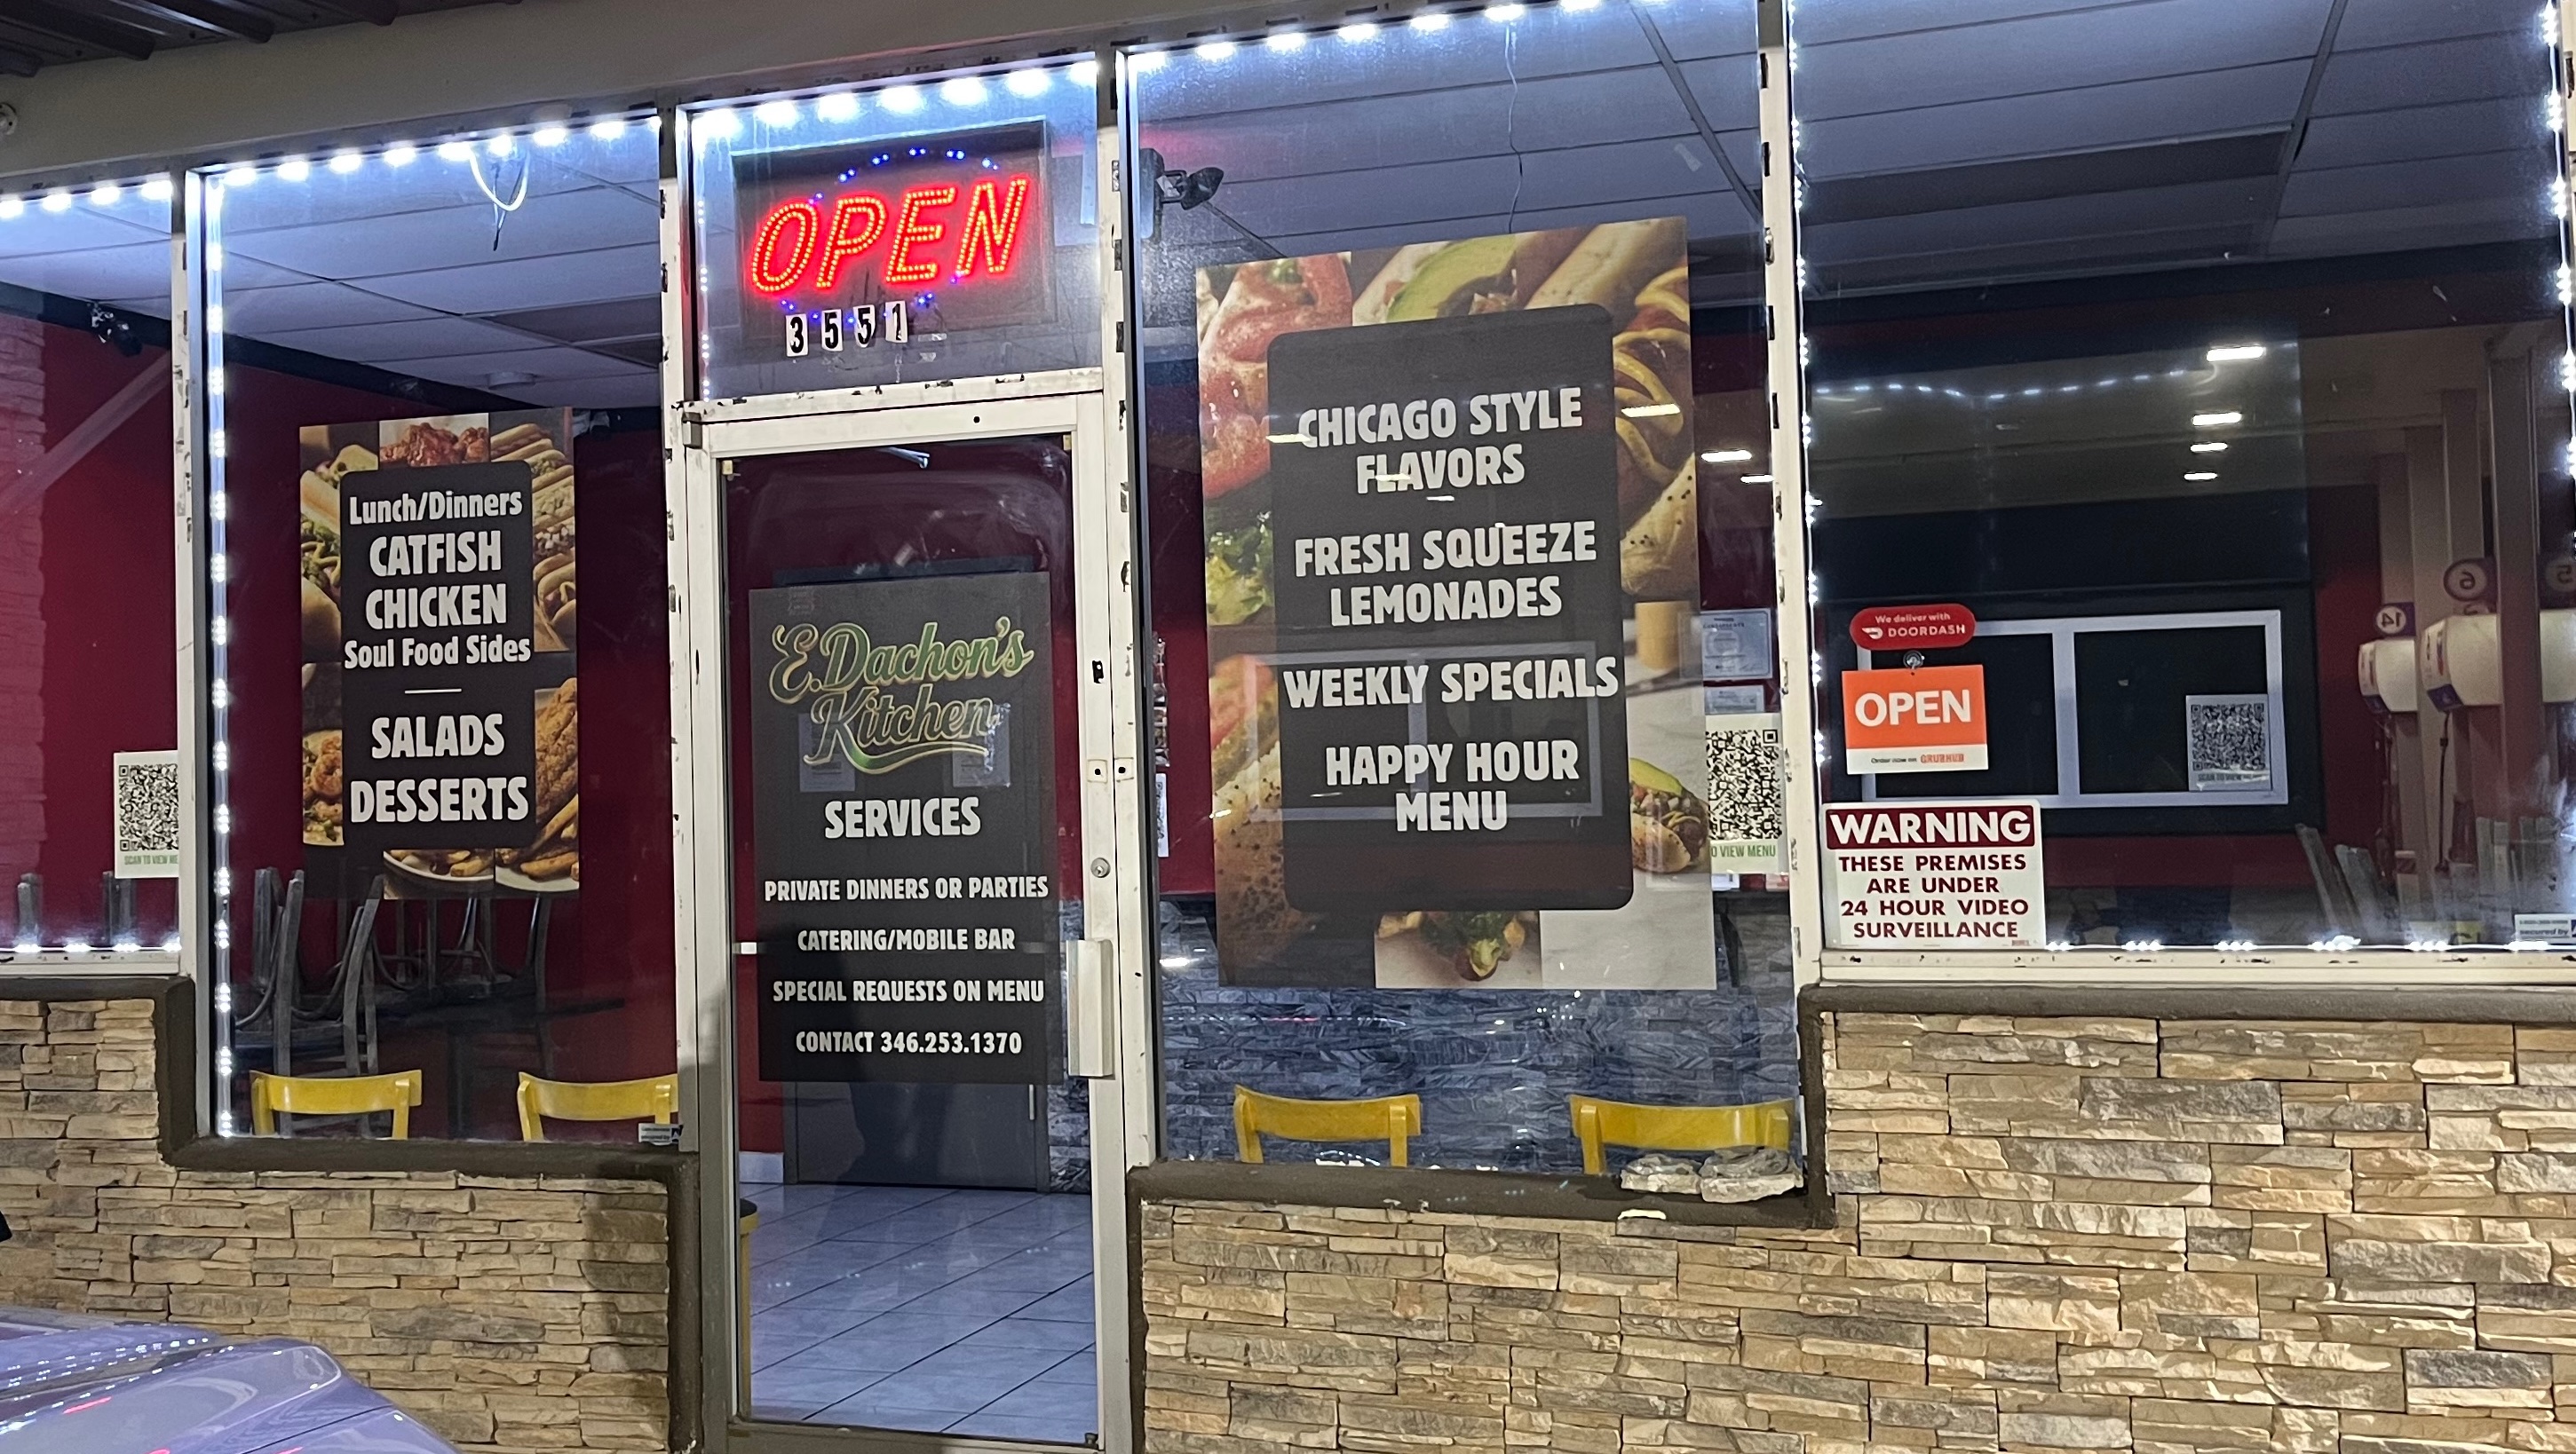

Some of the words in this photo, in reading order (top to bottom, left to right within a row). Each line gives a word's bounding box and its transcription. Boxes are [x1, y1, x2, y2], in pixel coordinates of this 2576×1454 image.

[750, 177, 1029, 293] OPEN
[789, 303, 904, 355] 3551
[1297, 398, 1456, 448] CHICAGO
[1469, 386, 1582, 436] STYLE
[1356, 443, 1526, 494] FLAVORS
[349, 490, 523, 525] Lunch/Dinners
[369, 530, 502, 576] CATFISH
[1295, 532, 1411, 578] FRESH
[1423, 520, 1597, 571] SQUEEZE
[365, 583, 507, 629] CHICKEN
[1330, 574, 1563, 627] LEMONADES
[1875, 615, 1891, 624] We
[1893, 613, 1927, 623] deliver
[1928, 612, 1952, 621] with
[1888, 623, 1966, 637] DOORDASH
[345, 638, 394, 669] Soul
[402, 636, 458, 667] Food
[466, 634, 531, 664] Sides
[1282, 664, 1430, 708] WEEKLY
[1440, 656, 1619, 703] SPECIALS
[1855, 689, 1971, 727] OPEN
[371, 714, 504, 758] SALADS
[803, 683, 996, 774] Kitchen
[1326, 743, 1454, 786] HAPPY
[1465, 739, 1581, 783] HOUR
[351, 777, 529, 823] DESSERTS
[825, 796, 981, 839] SERVICES
[1395, 789, 1509, 833] MENU
[1829, 810, 2031, 844] WARNING
[1719, 845, 1745, 857] VIEW
[1747, 844, 1776, 857] MENU
[1838, 856, 1904, 872] THESE
[1915, 854, 2026, 872] PREMISES
[765, 880, 840, 901] PRIVATE
[846, 878, 929, 900] DINNERS
[935, 877, 963, 899] OR
[968, 875, 1049, 898] PARTIES
[1867, 877, 1910, 894] ARE
[1922, 876, 2000, 893] UNDER
[1841, 900, 1868, 916] 24
[1880, 899, 1946, 916] HOUR
[1957, 899, 2029, 915] VIDEO
[797, 929, 968, 951] CATERING/MOBILE
[974, 929, 1016, 951] BAR
[1853, 921, 2018, 938] SURVEILLANCE
[773, 980, 847, 1002] SPECIAL
[852, 980, 947, 1003] REQUESTS
[953, 980, 981, 1002] ON
[987, 980, 1044, 1002] MENU
[796, 1031, 875, 1053] CONTACT
[880, 1031, 1022, 1055] 346.253.1370
